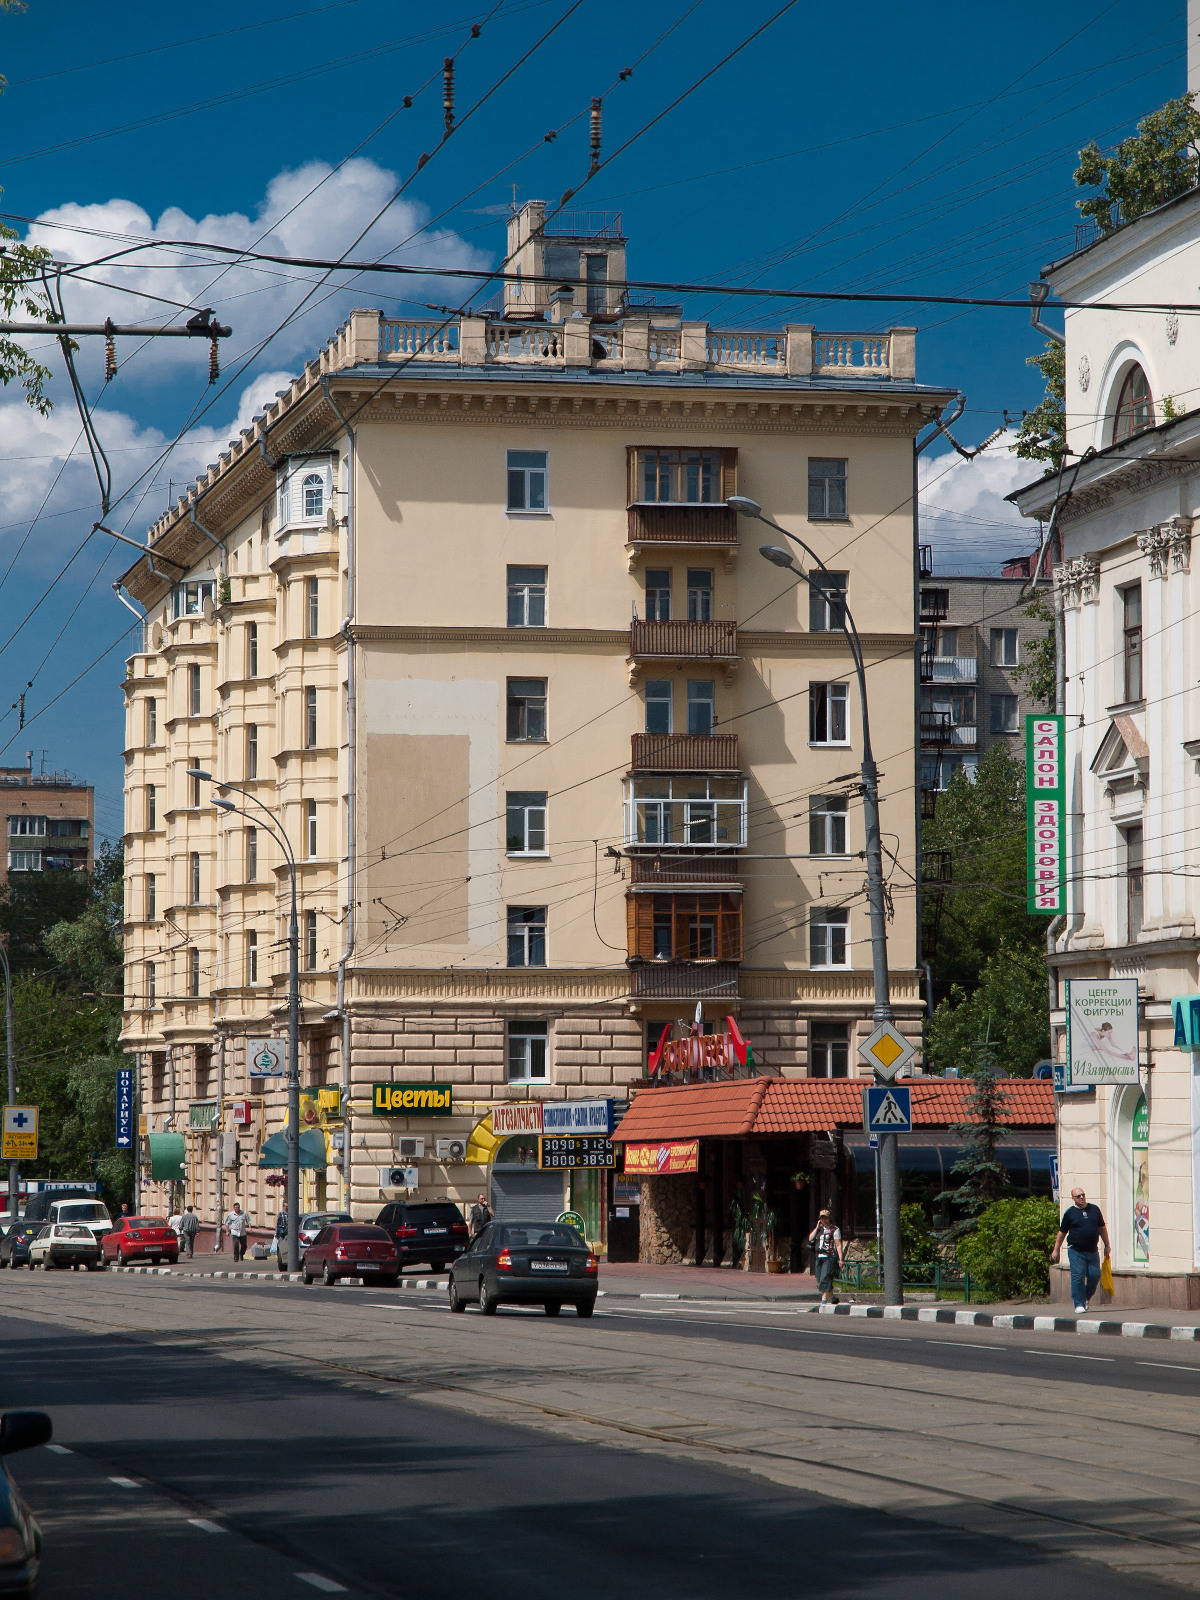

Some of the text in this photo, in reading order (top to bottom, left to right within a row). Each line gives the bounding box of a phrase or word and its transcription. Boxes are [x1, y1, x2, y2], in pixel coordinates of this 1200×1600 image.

[1037, 722, 1056, 907] САЛОН ЗДОРОВЬЯ
[1088, 988, 1118, 997] ЦЕНТР
[1075, 998, 1132, 1007] КОРРЕКЦИИ
[1083, 1008, 1124, 1016] ФИГУРЫ
[120, 1071, 130, 1134] НОТАРИУС
[376, 1087, 450, 1110] Цветы
[544, 1139, 575, 1151] 3090
[545, 1155, 576, 1166] 3800
[582, 1154, 613, 1165] 3850
